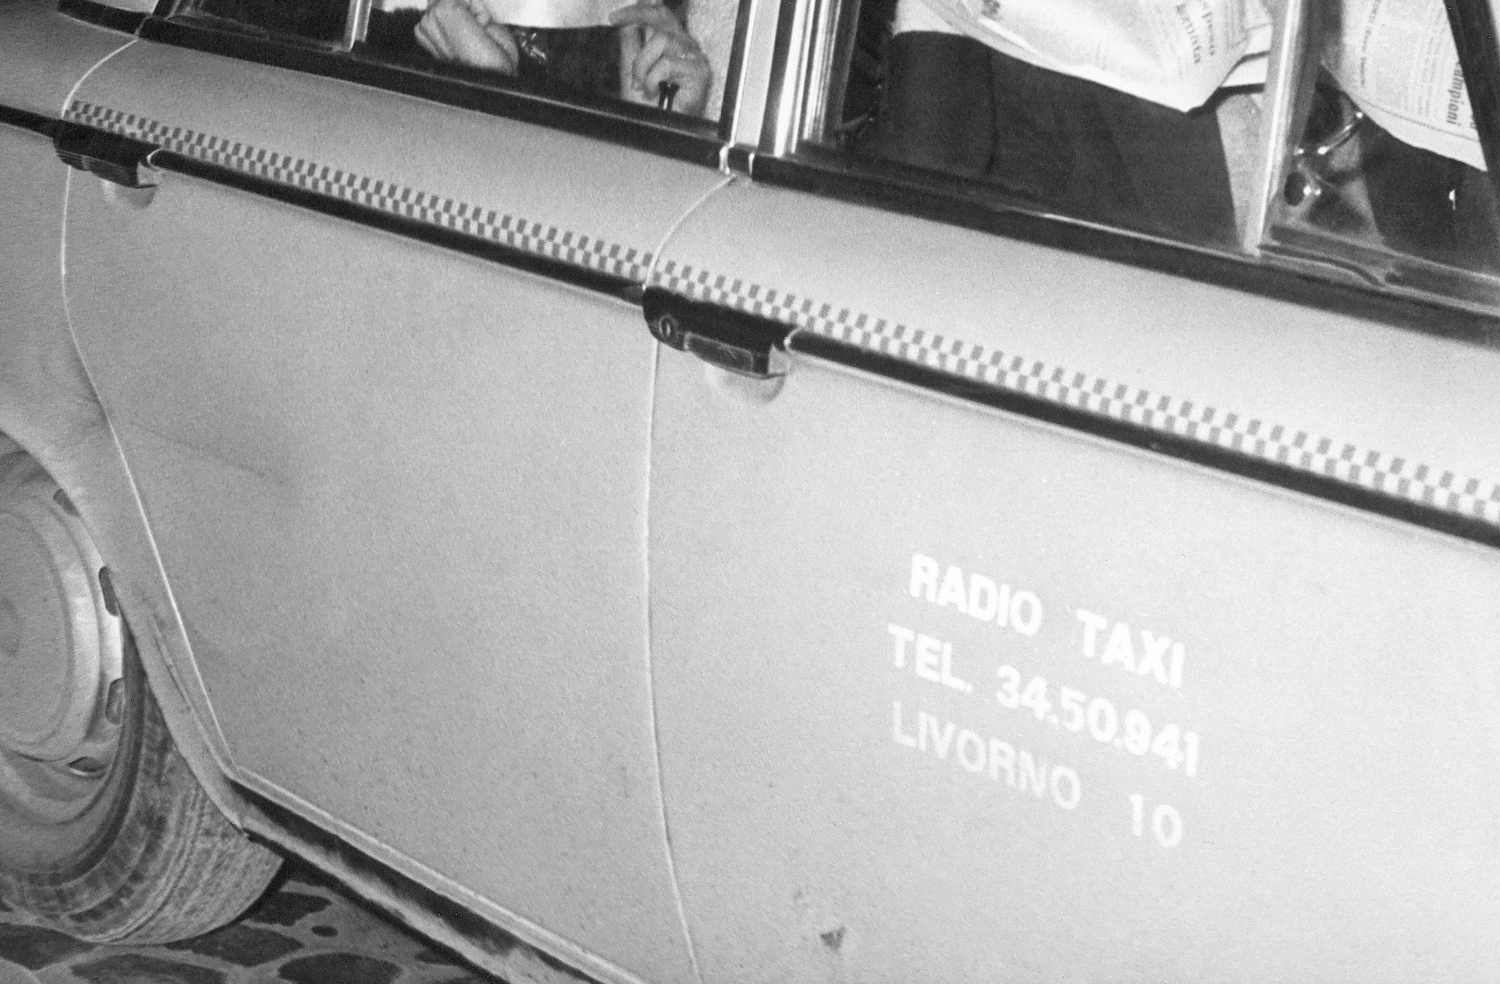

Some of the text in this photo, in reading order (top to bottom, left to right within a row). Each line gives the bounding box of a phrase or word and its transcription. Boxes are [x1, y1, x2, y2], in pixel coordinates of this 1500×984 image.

[910, 553, 1185, 688] RADIO TAXI
[893, 702, 1184, 848] LIVORNO 10
[996, 664, 1199, 778] 34.50.941
